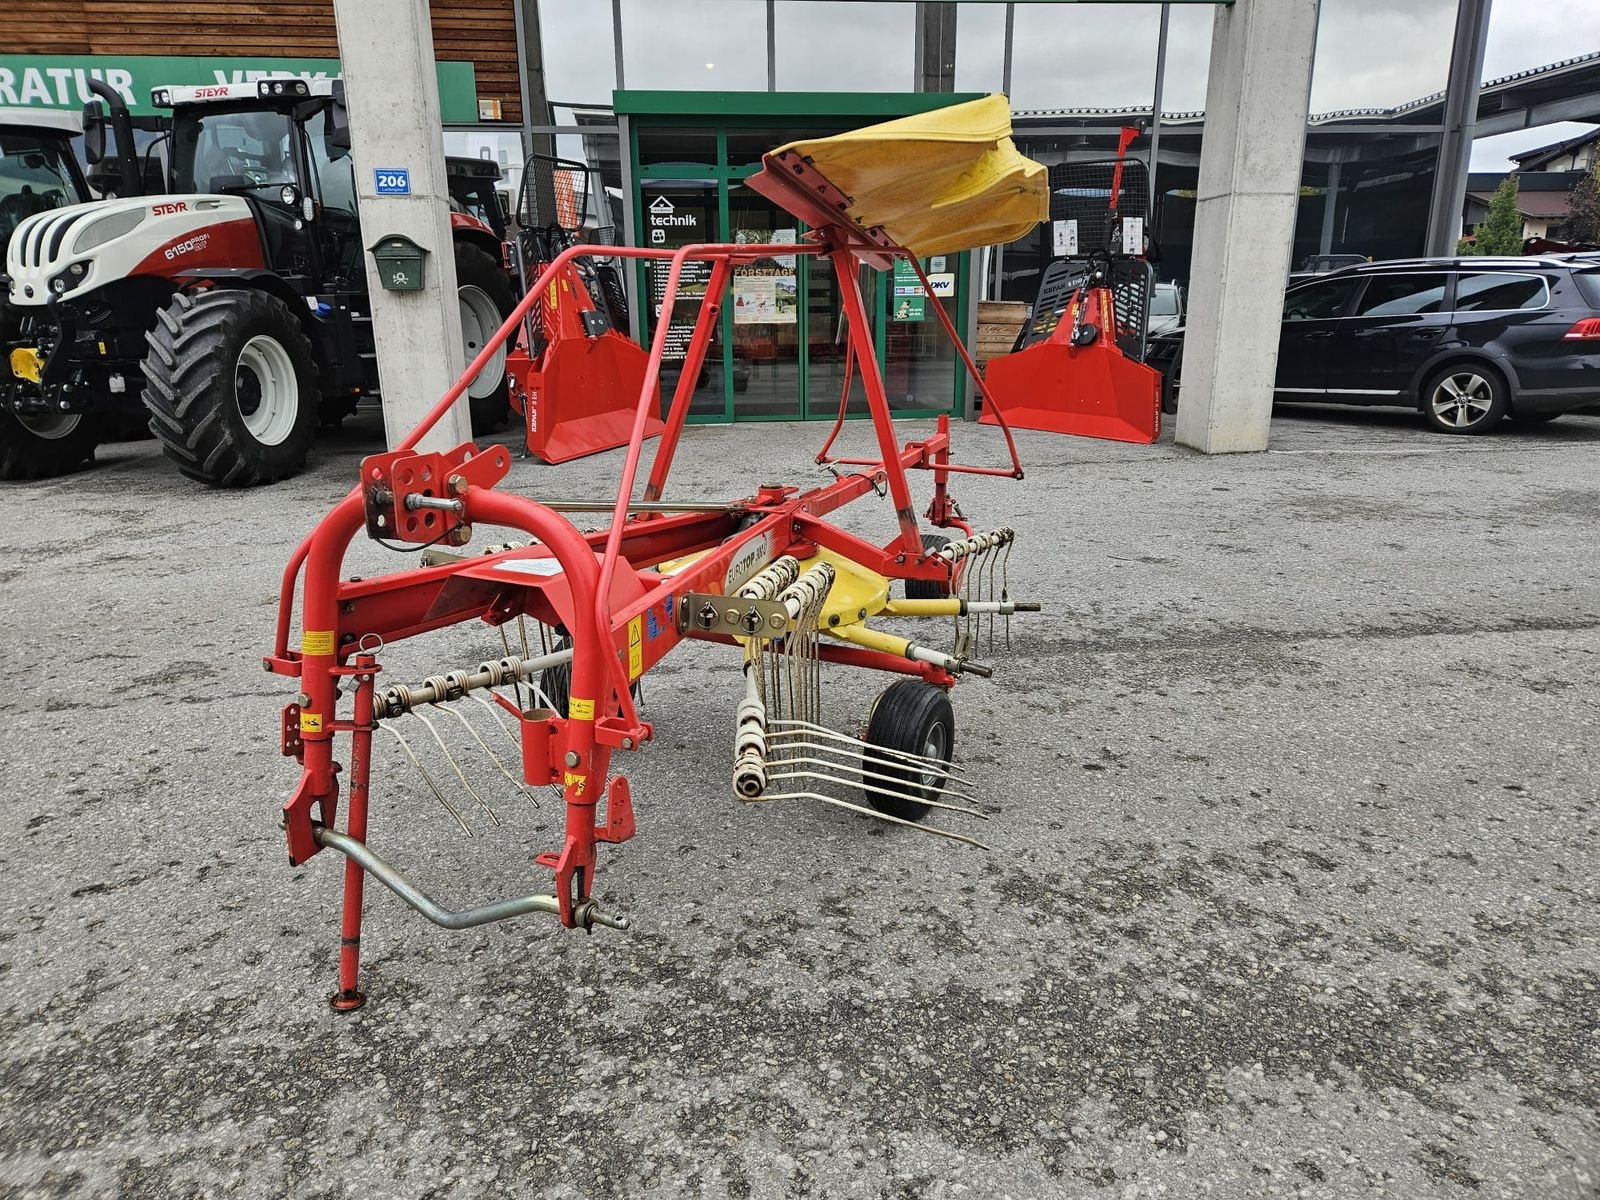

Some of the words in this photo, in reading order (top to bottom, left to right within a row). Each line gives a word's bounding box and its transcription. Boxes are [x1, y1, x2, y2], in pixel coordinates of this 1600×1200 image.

[194, 87, 228, 98] STEYR
[378, 175, 406, 187] 206
[152, 202, 188, 216] STEYR
[650, 215, 697, 226] technik
[164, 240, 195, 260] 6150
[190, 233, 211, 245] PROFI
[734, 268, 795, 277] FORSTTAGE
[728, 552, 755, 584] EUROTOP
